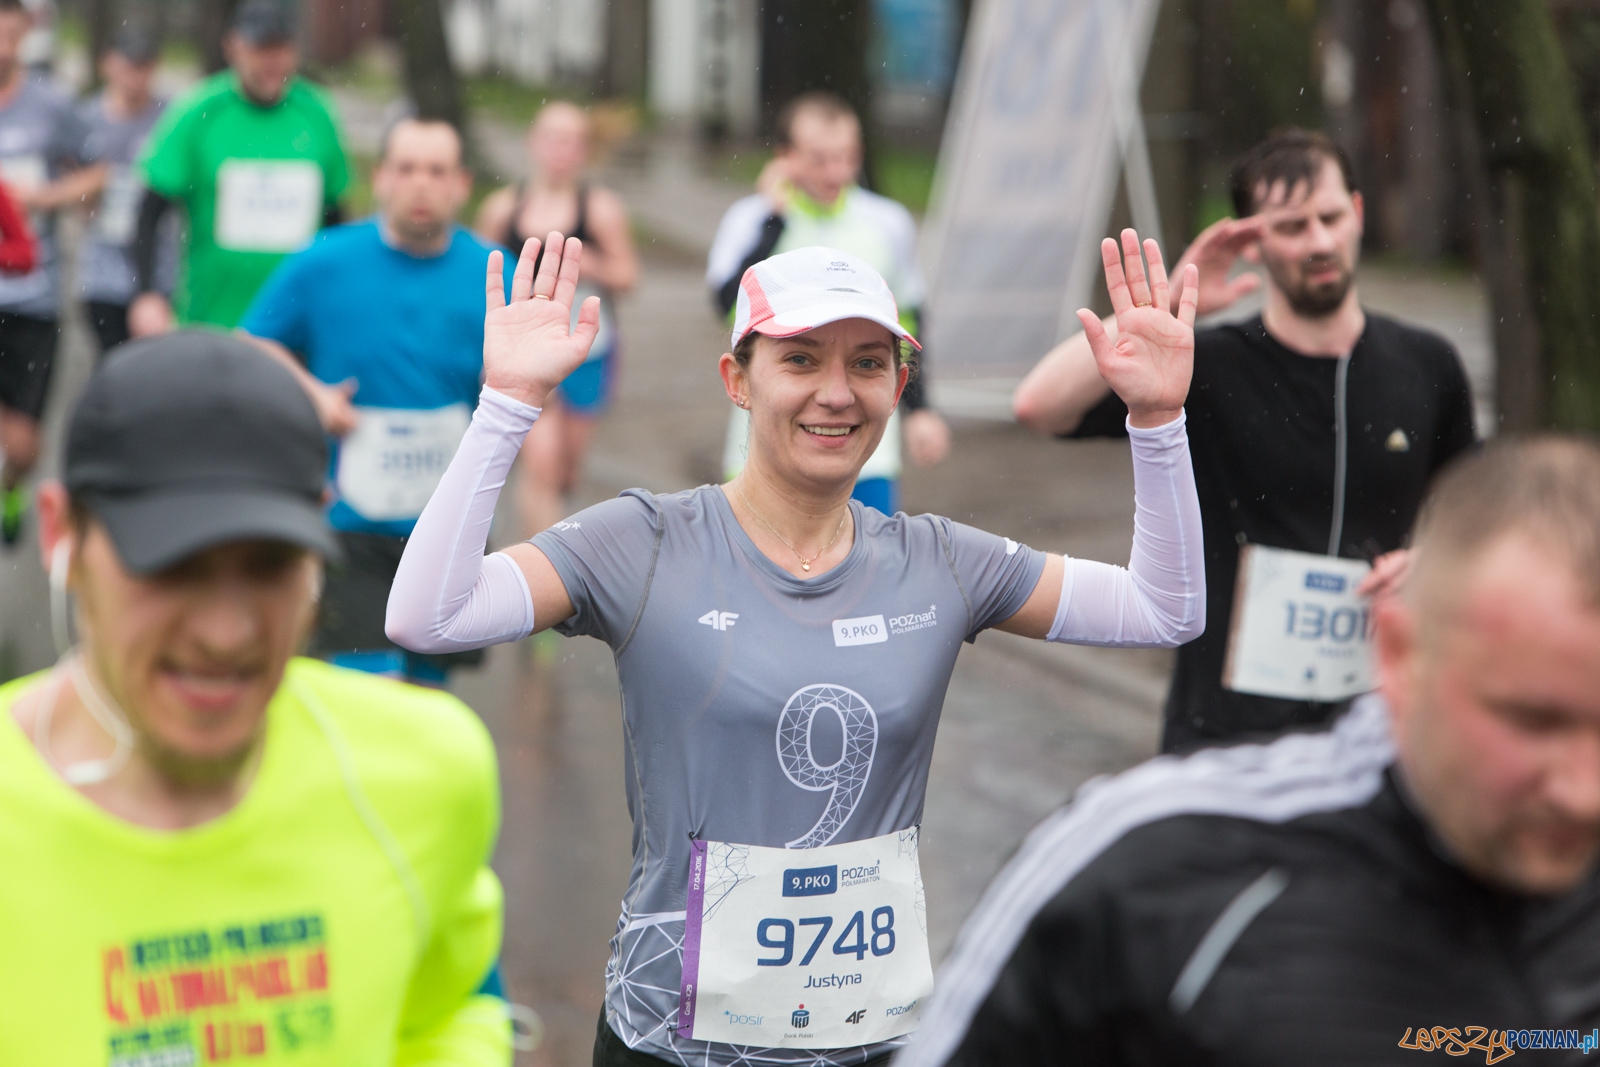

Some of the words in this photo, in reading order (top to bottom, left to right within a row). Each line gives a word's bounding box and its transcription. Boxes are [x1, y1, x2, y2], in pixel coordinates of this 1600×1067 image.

[698, 609, 740, 631] 4F
[776, 683, 879, 850] 9
[693, 855, 703, 891] 17.04.2016
[756, 905, 896, 967] 9748
[803, 972, 863, 990] Justyna
